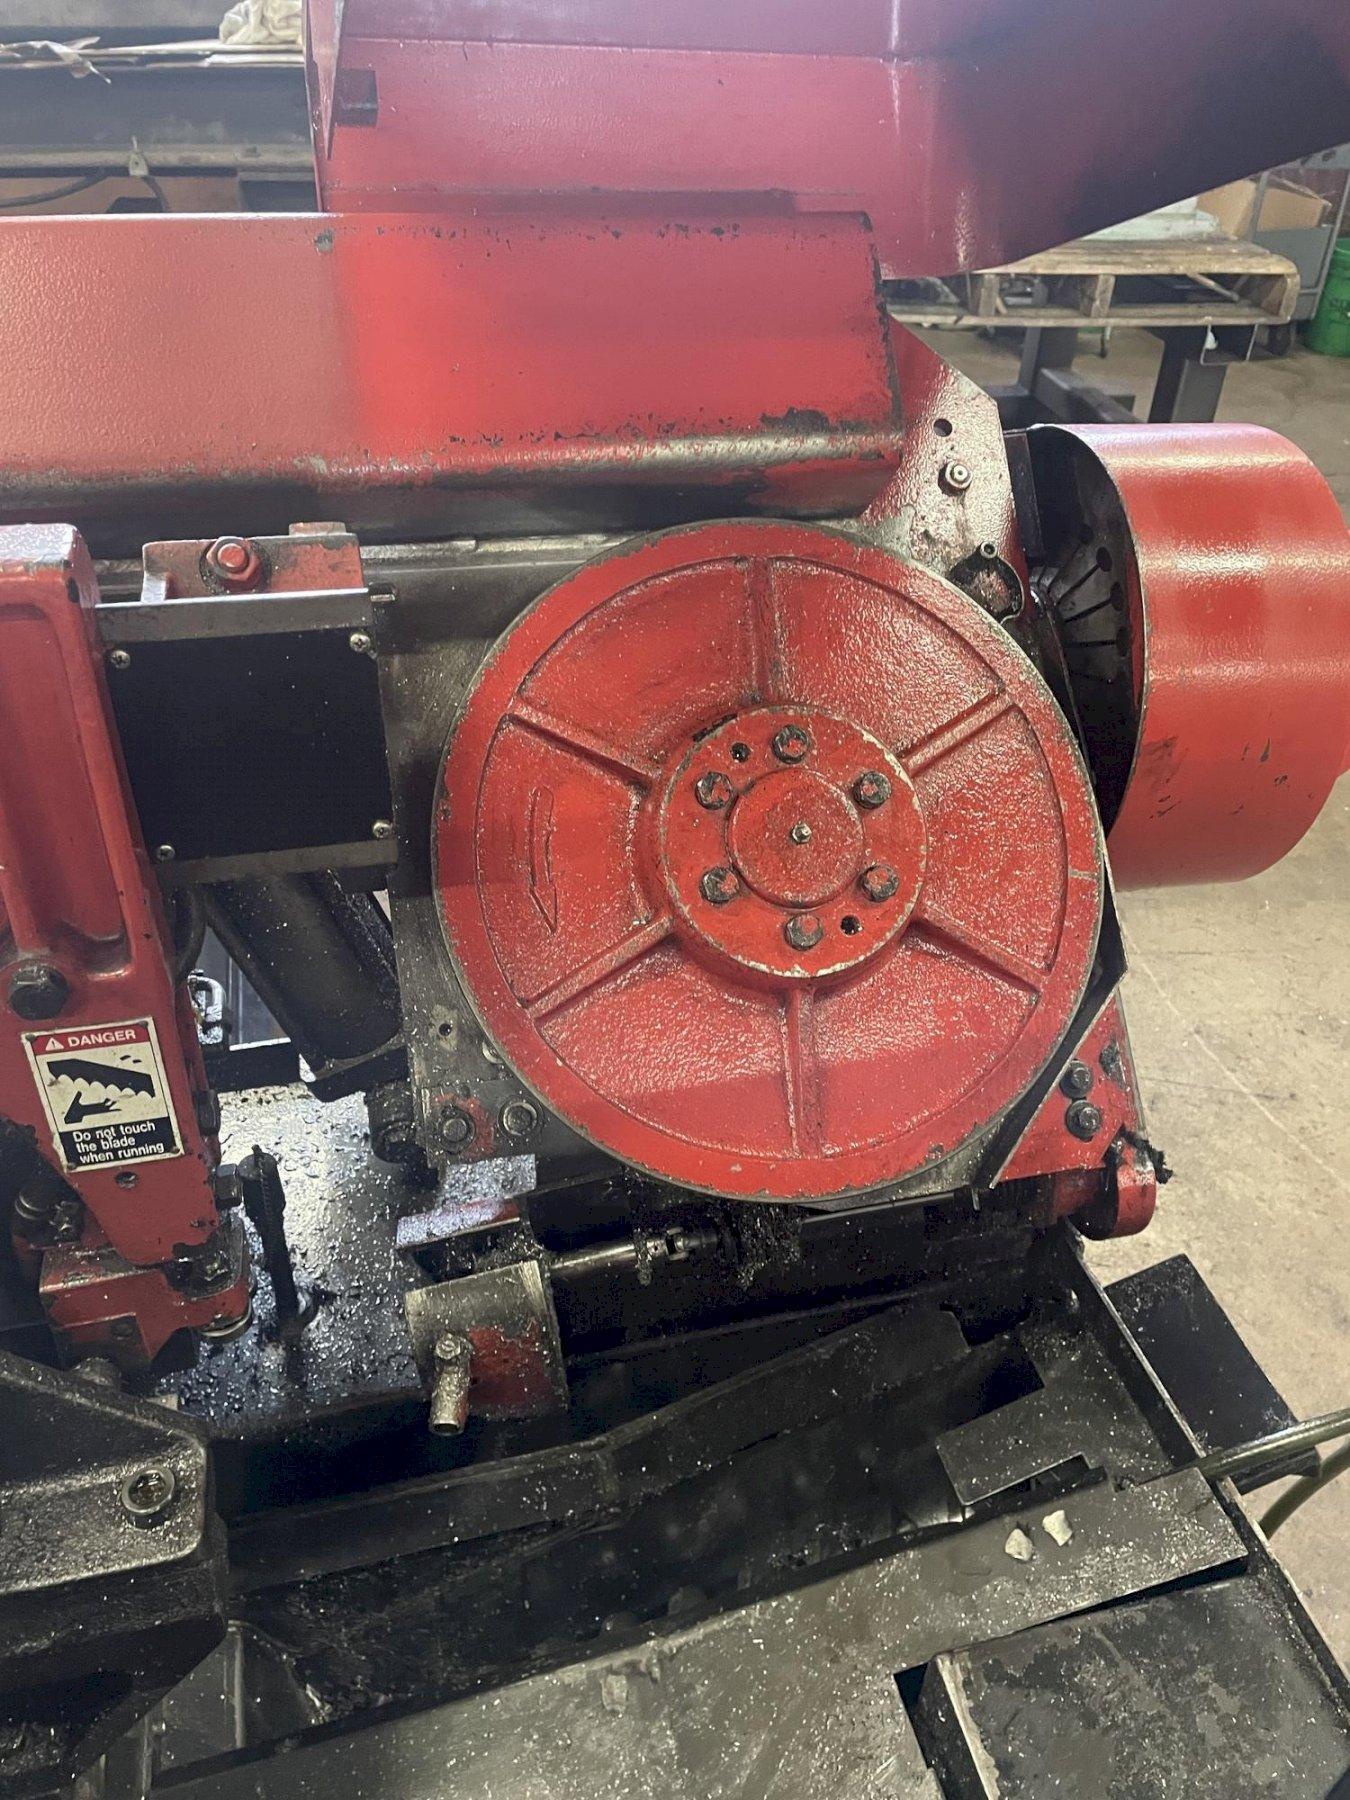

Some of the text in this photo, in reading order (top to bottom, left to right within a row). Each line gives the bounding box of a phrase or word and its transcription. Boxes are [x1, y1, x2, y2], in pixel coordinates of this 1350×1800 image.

[67, 1029, 136, 1047] DANGER
[72, 1121, 156, 1142] Do not touch
[76, 1136, 136, 1153] the blade
[79, 1143, 164, 1164] when running
